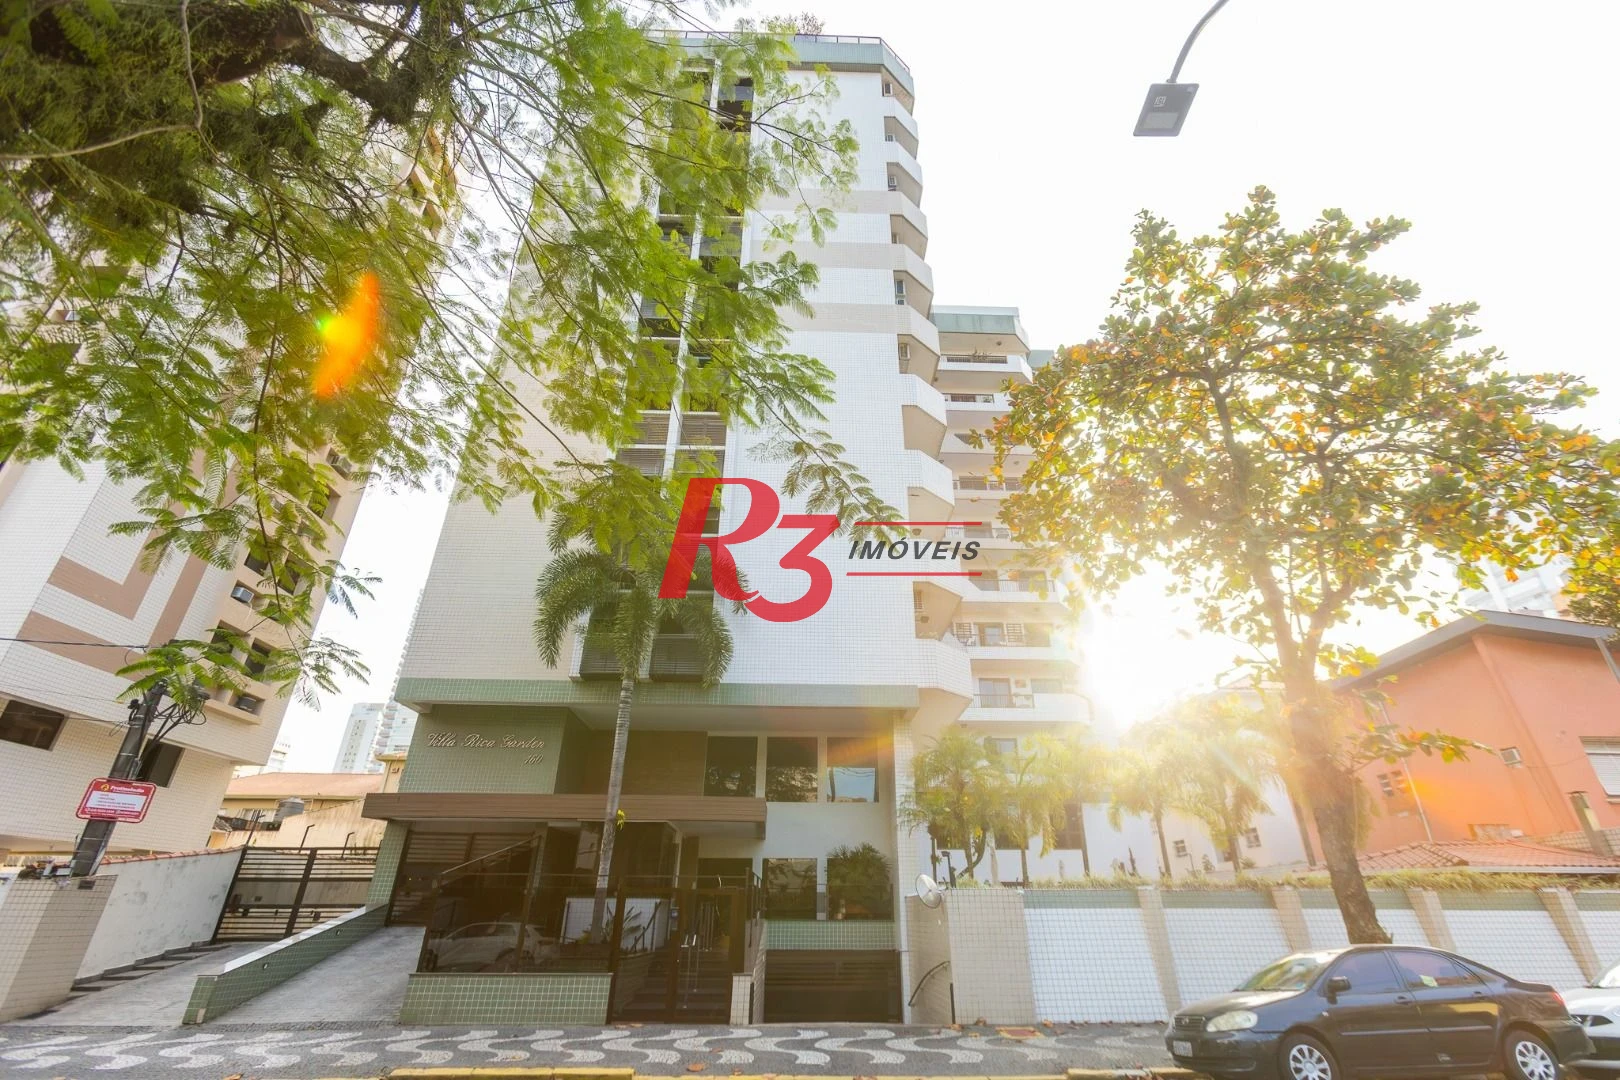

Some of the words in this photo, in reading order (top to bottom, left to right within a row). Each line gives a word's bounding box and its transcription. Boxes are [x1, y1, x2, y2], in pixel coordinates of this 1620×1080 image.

[426, 731, 457, 747] Villa
[462, 733, 495, 748] Rica
[500, 735, 542, 749] Garden
